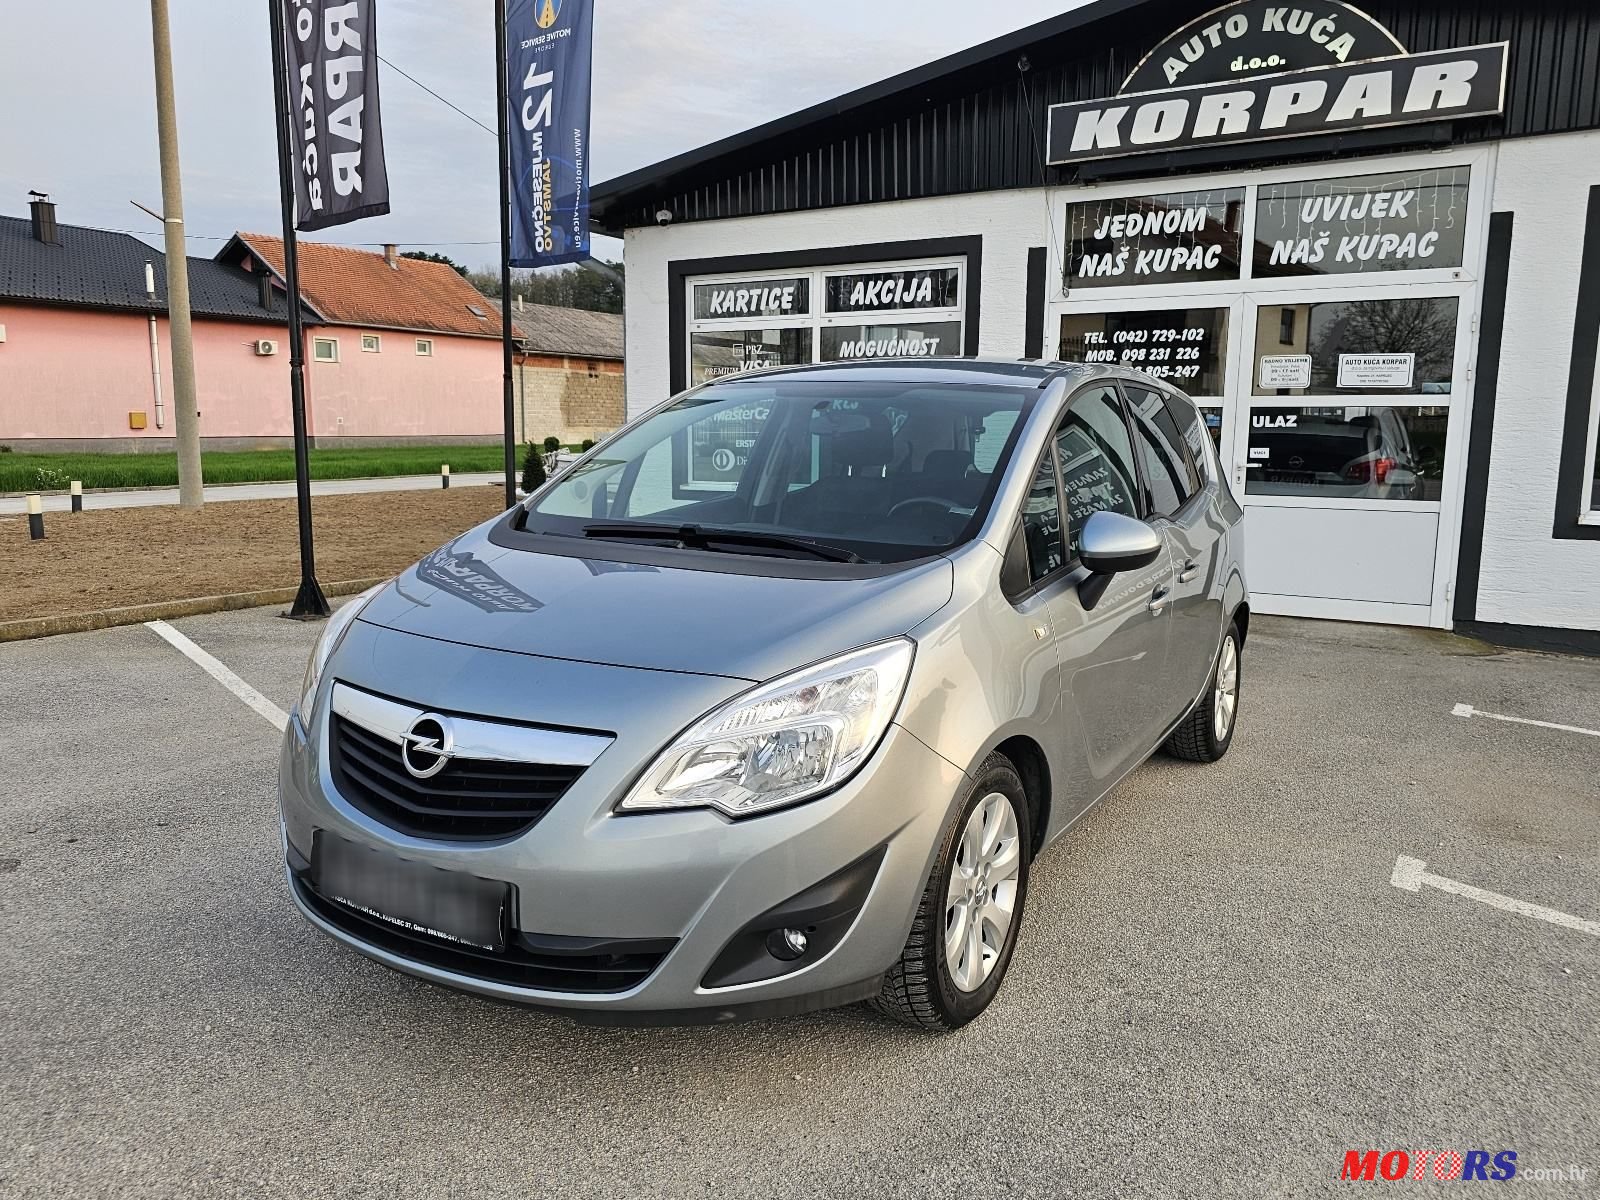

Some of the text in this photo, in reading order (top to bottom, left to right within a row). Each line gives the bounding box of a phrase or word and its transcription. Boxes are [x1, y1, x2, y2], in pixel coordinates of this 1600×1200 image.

[1162, 8, 1356, 84] AUTO KUĆA
[1230, 54, 1286, 71] d.o.o.
[1070, 60, 1478, 152] KORPAR
[1301, 190, 1415, 223] UVIJEK
[1094, 207, 1207, 240] JEDNOM
[1078, 245, 1222, 278] NAŠ KUPAC
[1269, 231, 1439, 265] NAŠ KUPAC
[710, 287, 794, 314] KARTICE
[850, 277, 932, 305] AKCIJA
[745, 344, 763, 354] PBZ
[839, 335, 940, 358] MOGUĆNOST
[1084, 328, 1205, 344] TEL. (042) 729-102
[1085, 347, 1200, 362] MOB. 098 231 226
[704, 367, 739, 375] PREMIUM
[1253, 415, 1297, 428] ULAZ
